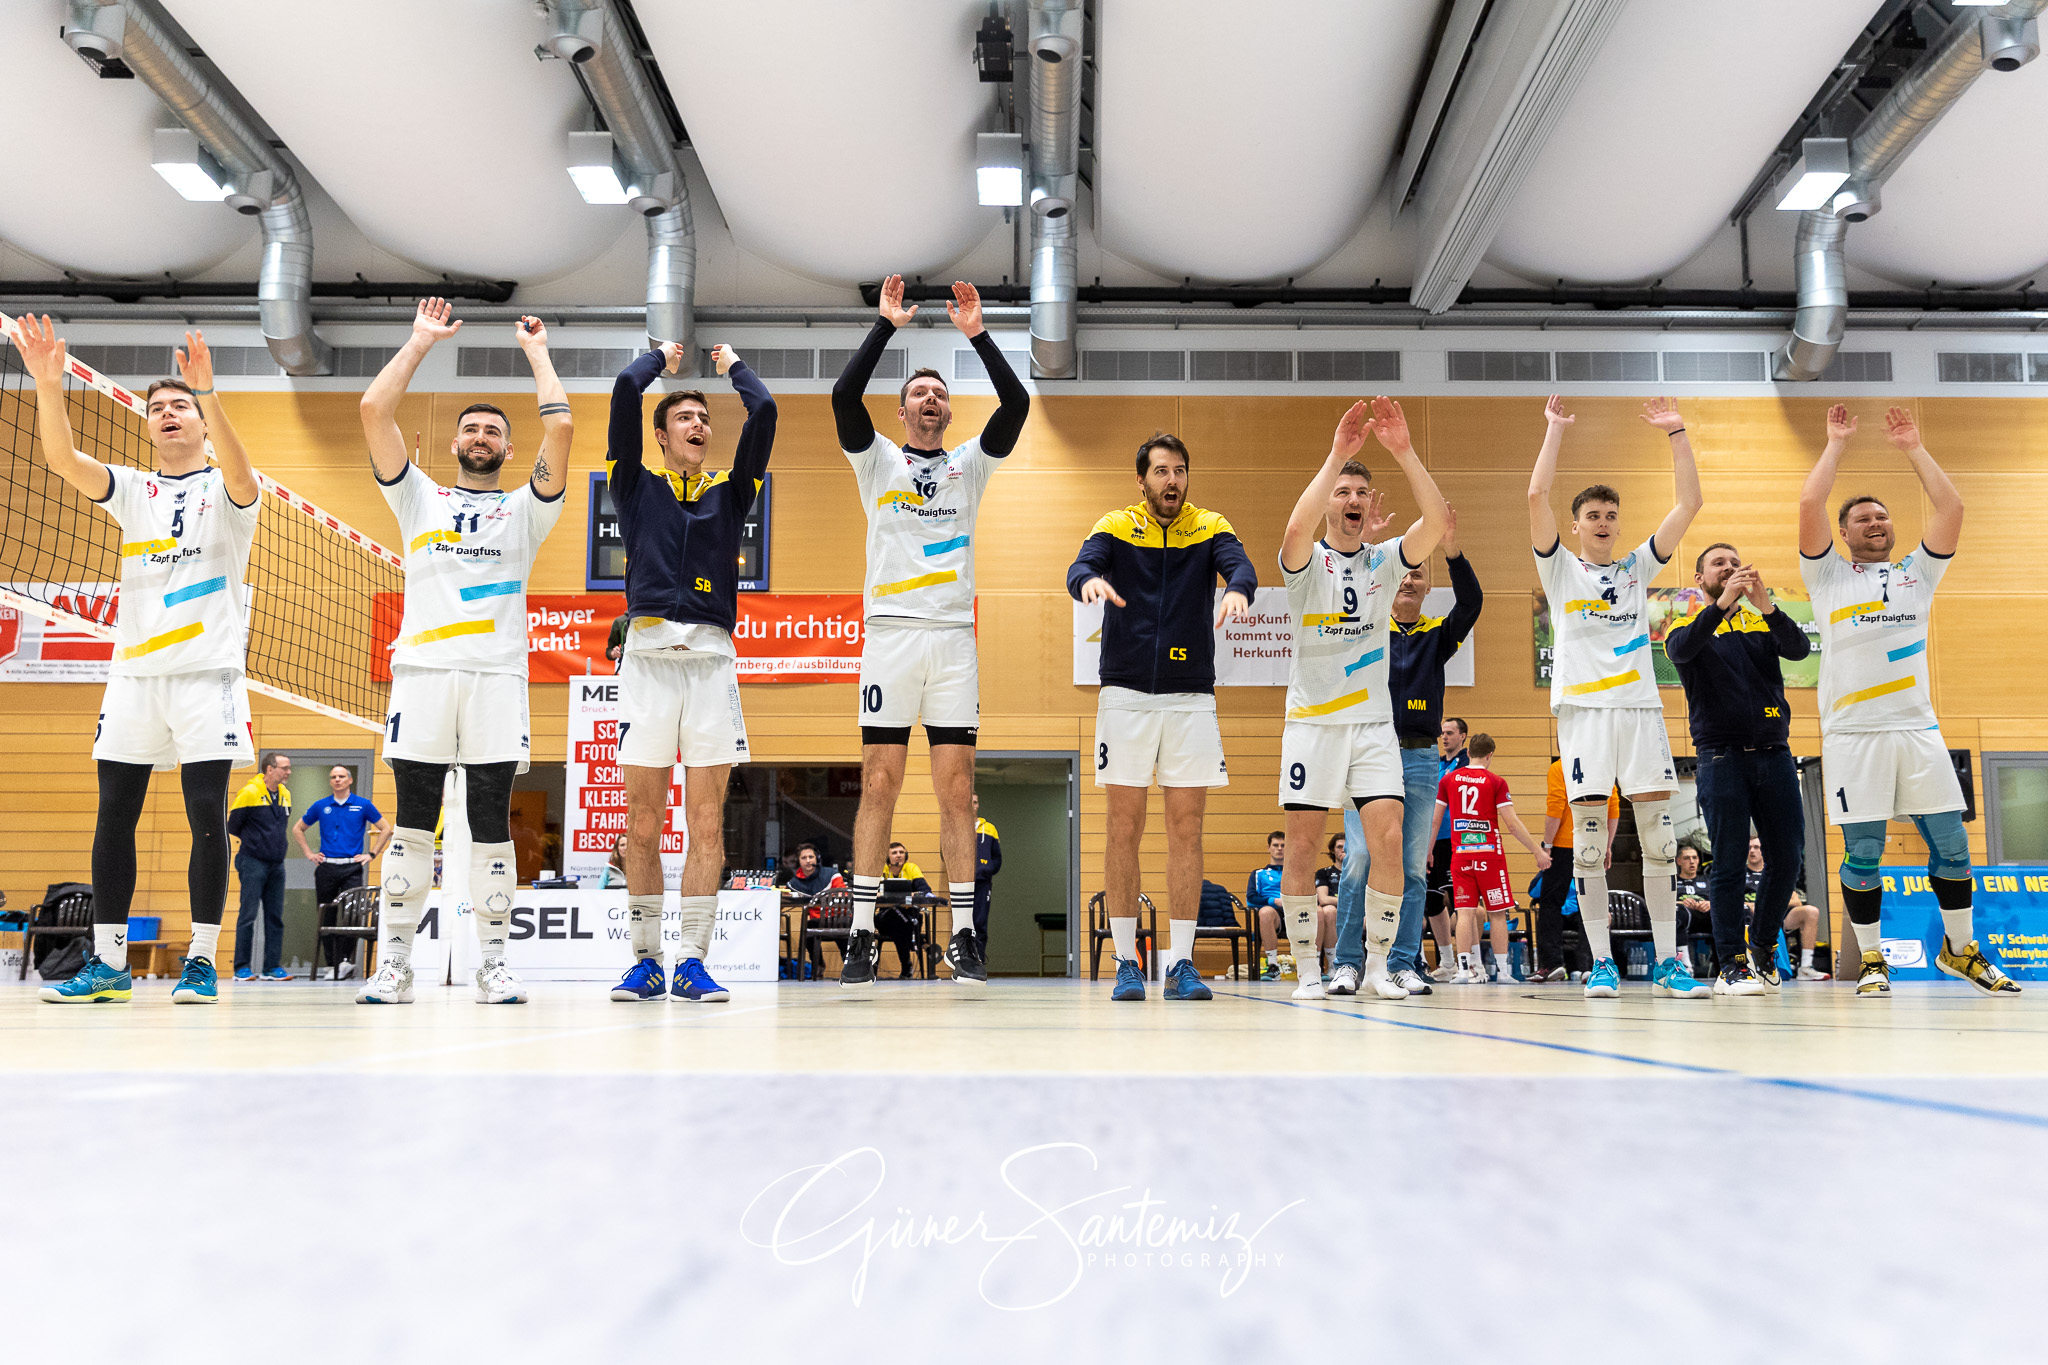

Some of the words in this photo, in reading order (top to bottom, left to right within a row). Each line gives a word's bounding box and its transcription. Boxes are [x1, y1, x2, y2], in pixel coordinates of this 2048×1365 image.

[913, 478, 937, 498] 10
[918, 508, 957, 518] Daigfuss
[171, 507, 185, 538] 5
[453, 512, 480, 533] 11
[694, 577, 711, 593] SB
[1343, 587, 1358, 615] 9
[1601, 587, 1618, 605] 4
[734, 614, 766, 639] du
[1860, 615, 1881, 624] Zapf
[1882, 614, 1917, 623] Daigfuss
[1225, 630, 1272, 641] kommt
[1275, 633, 1293, 641] vo
[1169, 647, 1187, 661] CS
[1233, 647, 1292, 658] Herkunft
[863, 684, 883, 713] 10
[1408, 699, 1426, 710] MM
[1764, 707, 1781, 718] SK
[619, 722, 631, 752] 7
[1290, 762, 1306, 791] 9
[1572, 757, 1584, 784] 4
[1458, 785, 1479, 815] 12
[1836, 787, 1849, 812] 1
[1474, 861, 1487, 871] LS
[732, 877, 747, 889] 25
[1983, 876, 2018, 892] EIN
[1988, 934, 2004, 945] SV
